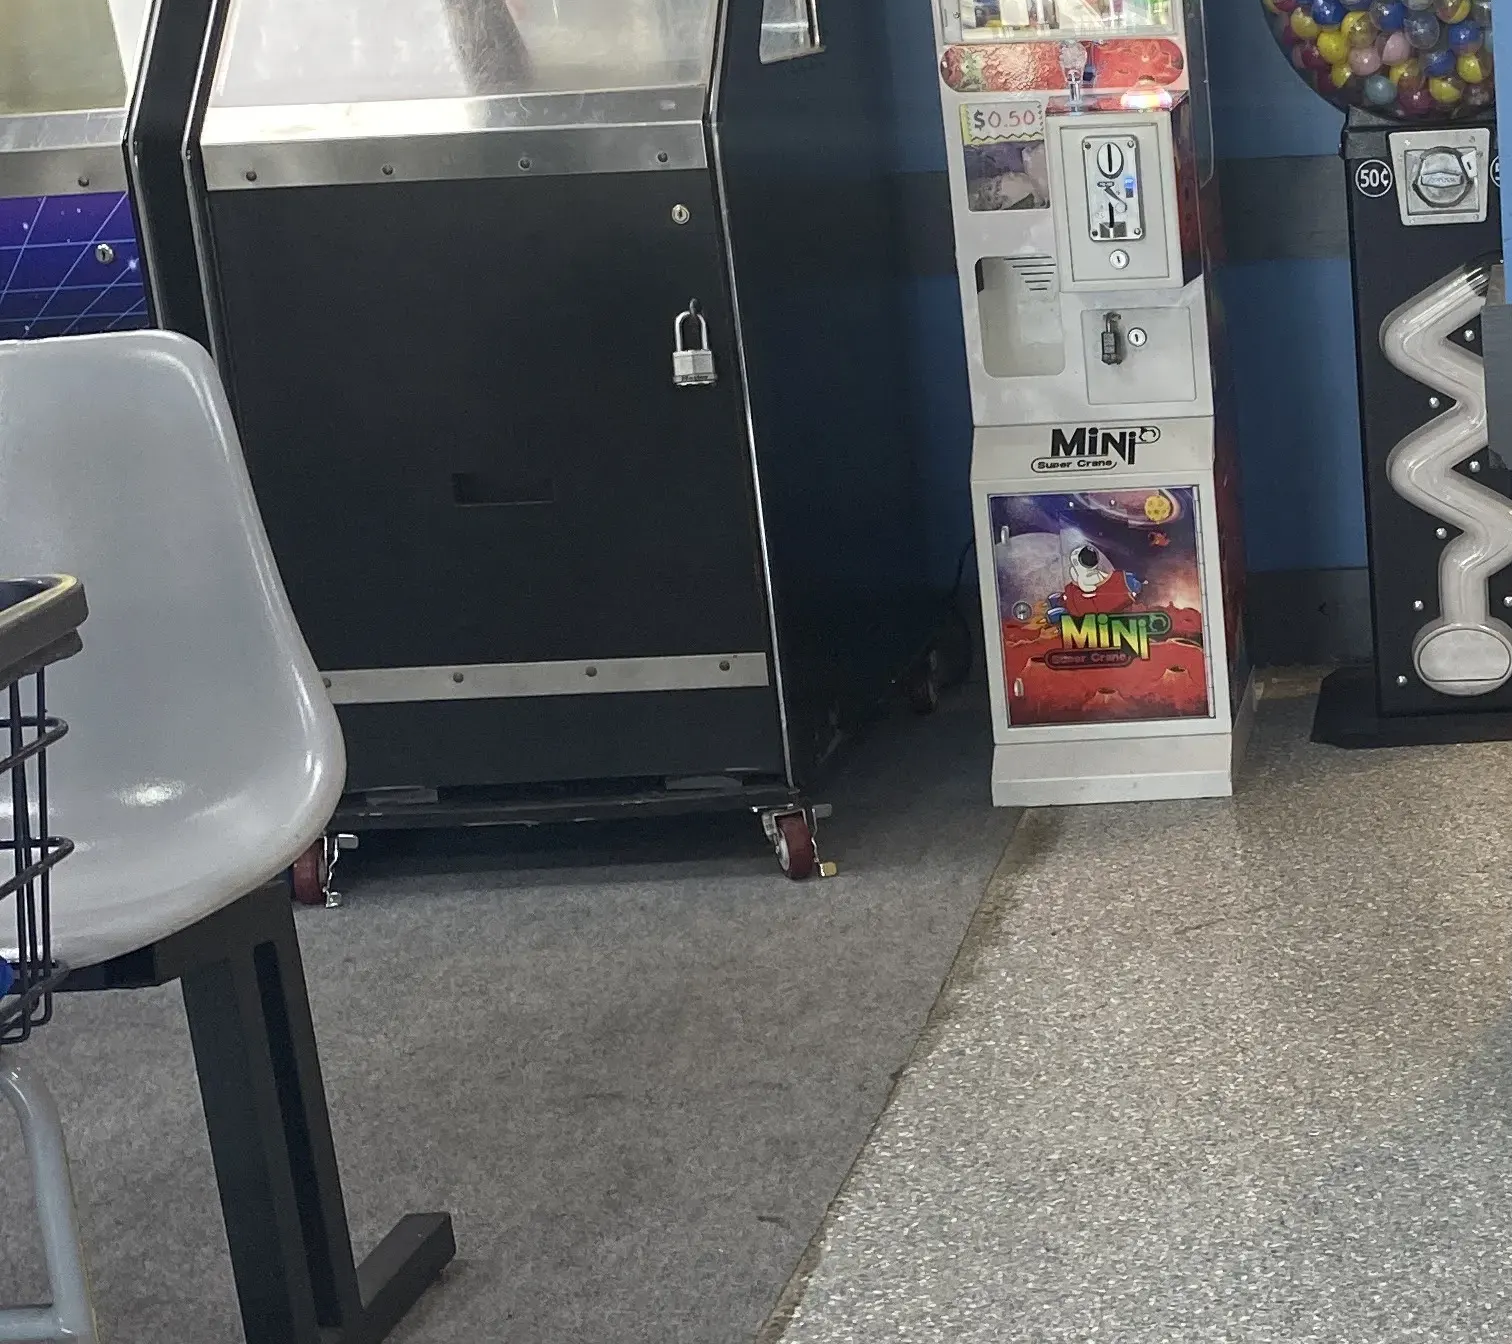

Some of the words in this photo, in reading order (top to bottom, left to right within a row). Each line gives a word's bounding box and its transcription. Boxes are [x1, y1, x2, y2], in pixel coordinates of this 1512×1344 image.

[973, 109, 1035, 131] $0.50
[1360, 167, 1389, 188] 50¢
[1037, 461, 1072, 469] Super
[1077, 459, 1113, 467] Crane
